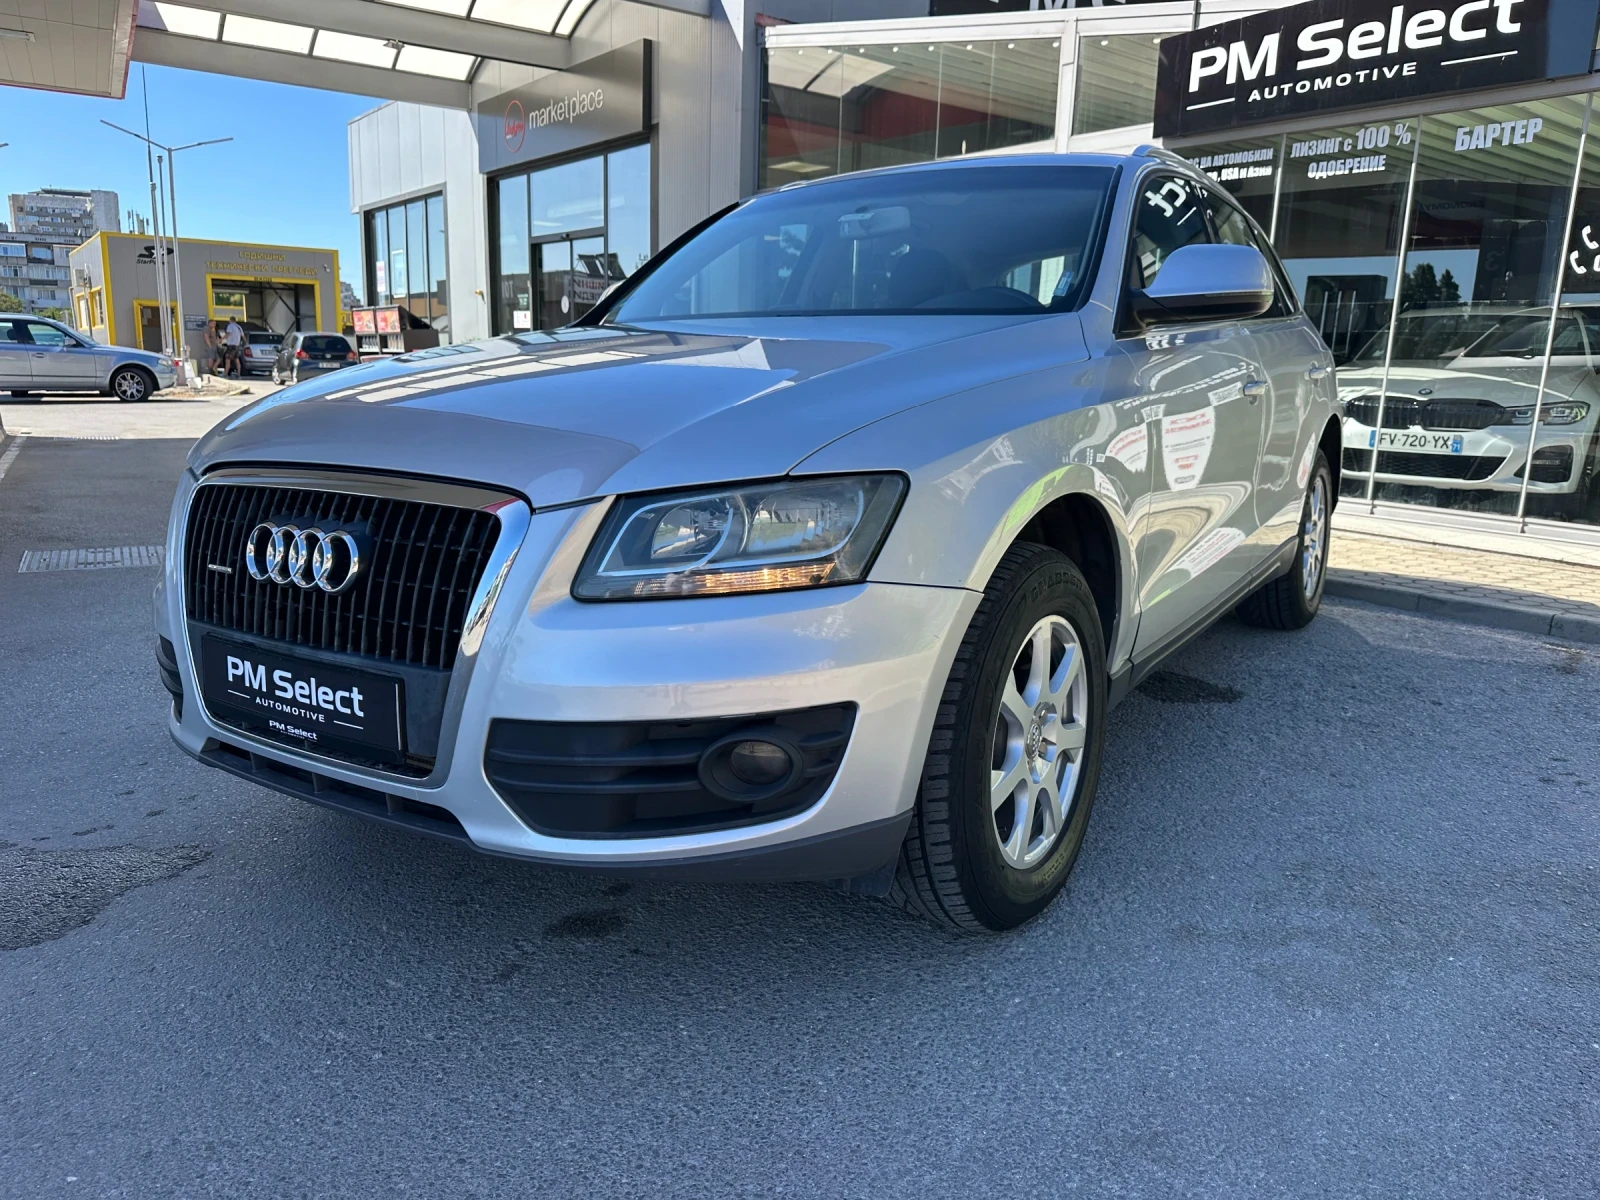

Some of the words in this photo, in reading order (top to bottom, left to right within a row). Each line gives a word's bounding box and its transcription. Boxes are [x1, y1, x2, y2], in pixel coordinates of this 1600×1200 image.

[1188, 32, 1281, 93] PM
[1296, 0, 1524, 71] Select
[1248, 61, 1418, 102] AUTOMOTIVE
[529, 88, 604, 130] marketplace
[1290, 137, 1342, 159] ЛИЗИНГ
[1356, 125, 1391, 150] 100
[1394, 122, 1412, 146] %
[1454, 117, 1543, 151] БАРТЕР
[1212, 148, 1274, 167] АВТОМОБИЛИ
[1307, 154, 1387, 180] ОДОБРЕНИЕ
[1221, 166, 1239, 181] USA
[206, 261, 268, 272] ТЕХНИЧЕСКИ
[239, 250, 285, 261] ГОДИШНИ
[226, 655, 267, 692] PM
[273, 669, 365, 717] Select
[255, 696, 326, 723] AUTOMOTIVE
[269, 719, 285, 731] PM
[286, 725, 318, 740] Select
